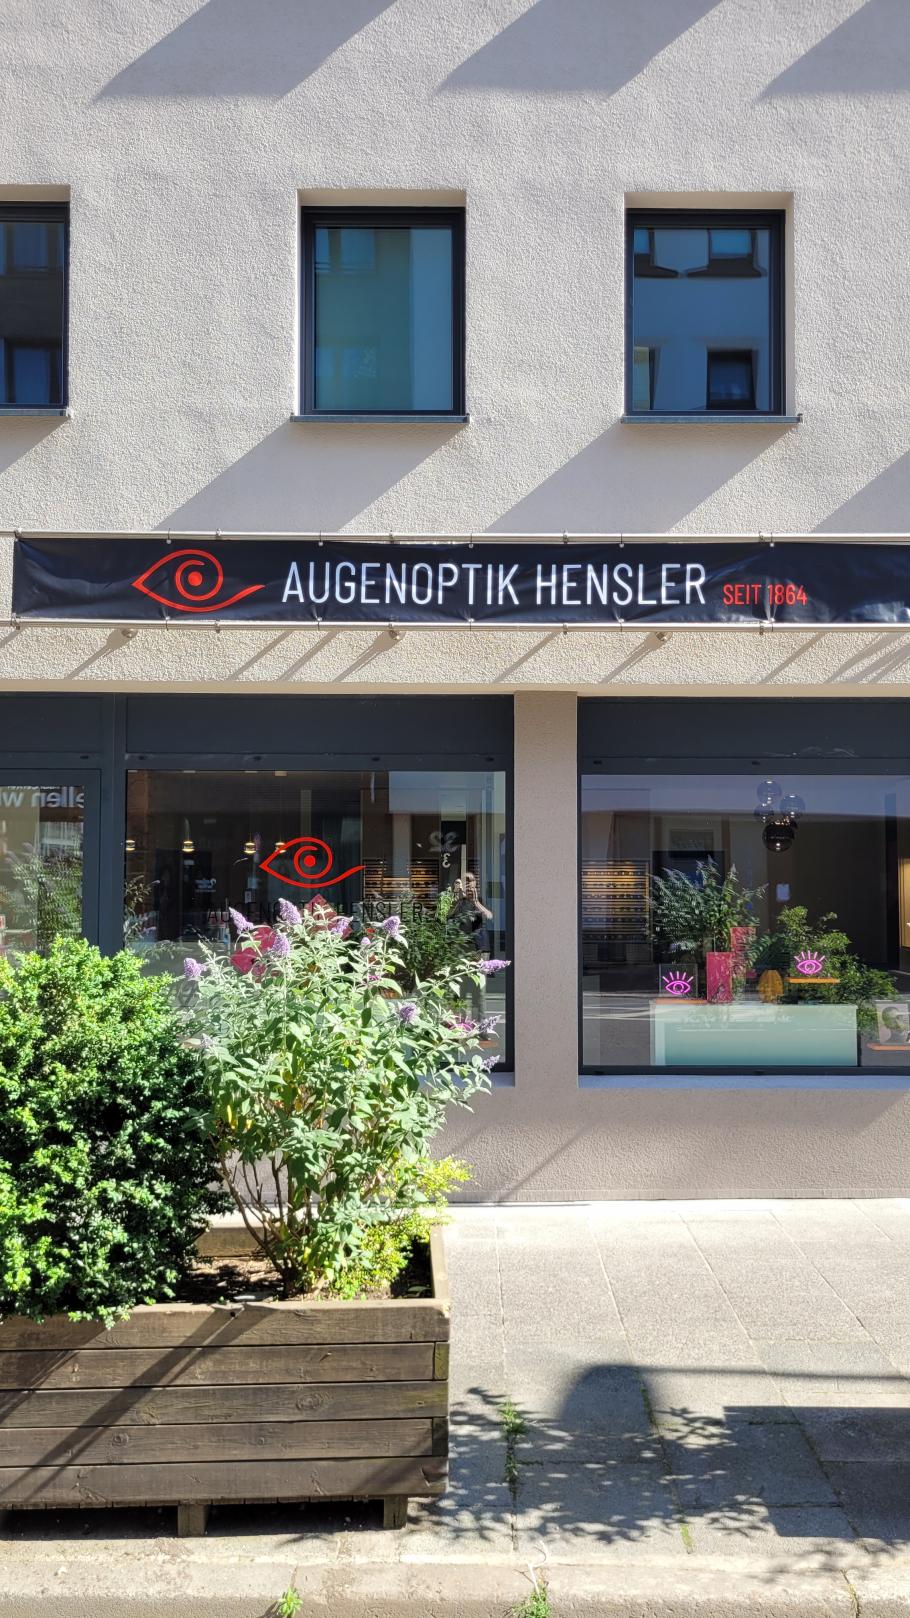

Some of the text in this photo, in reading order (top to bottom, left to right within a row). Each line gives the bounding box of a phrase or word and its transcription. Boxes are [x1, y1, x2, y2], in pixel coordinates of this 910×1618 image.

[281, 561, 706, 606] AUGENOPTIK HENSLER
[723, 584, 808, 606] SEIT 1864
